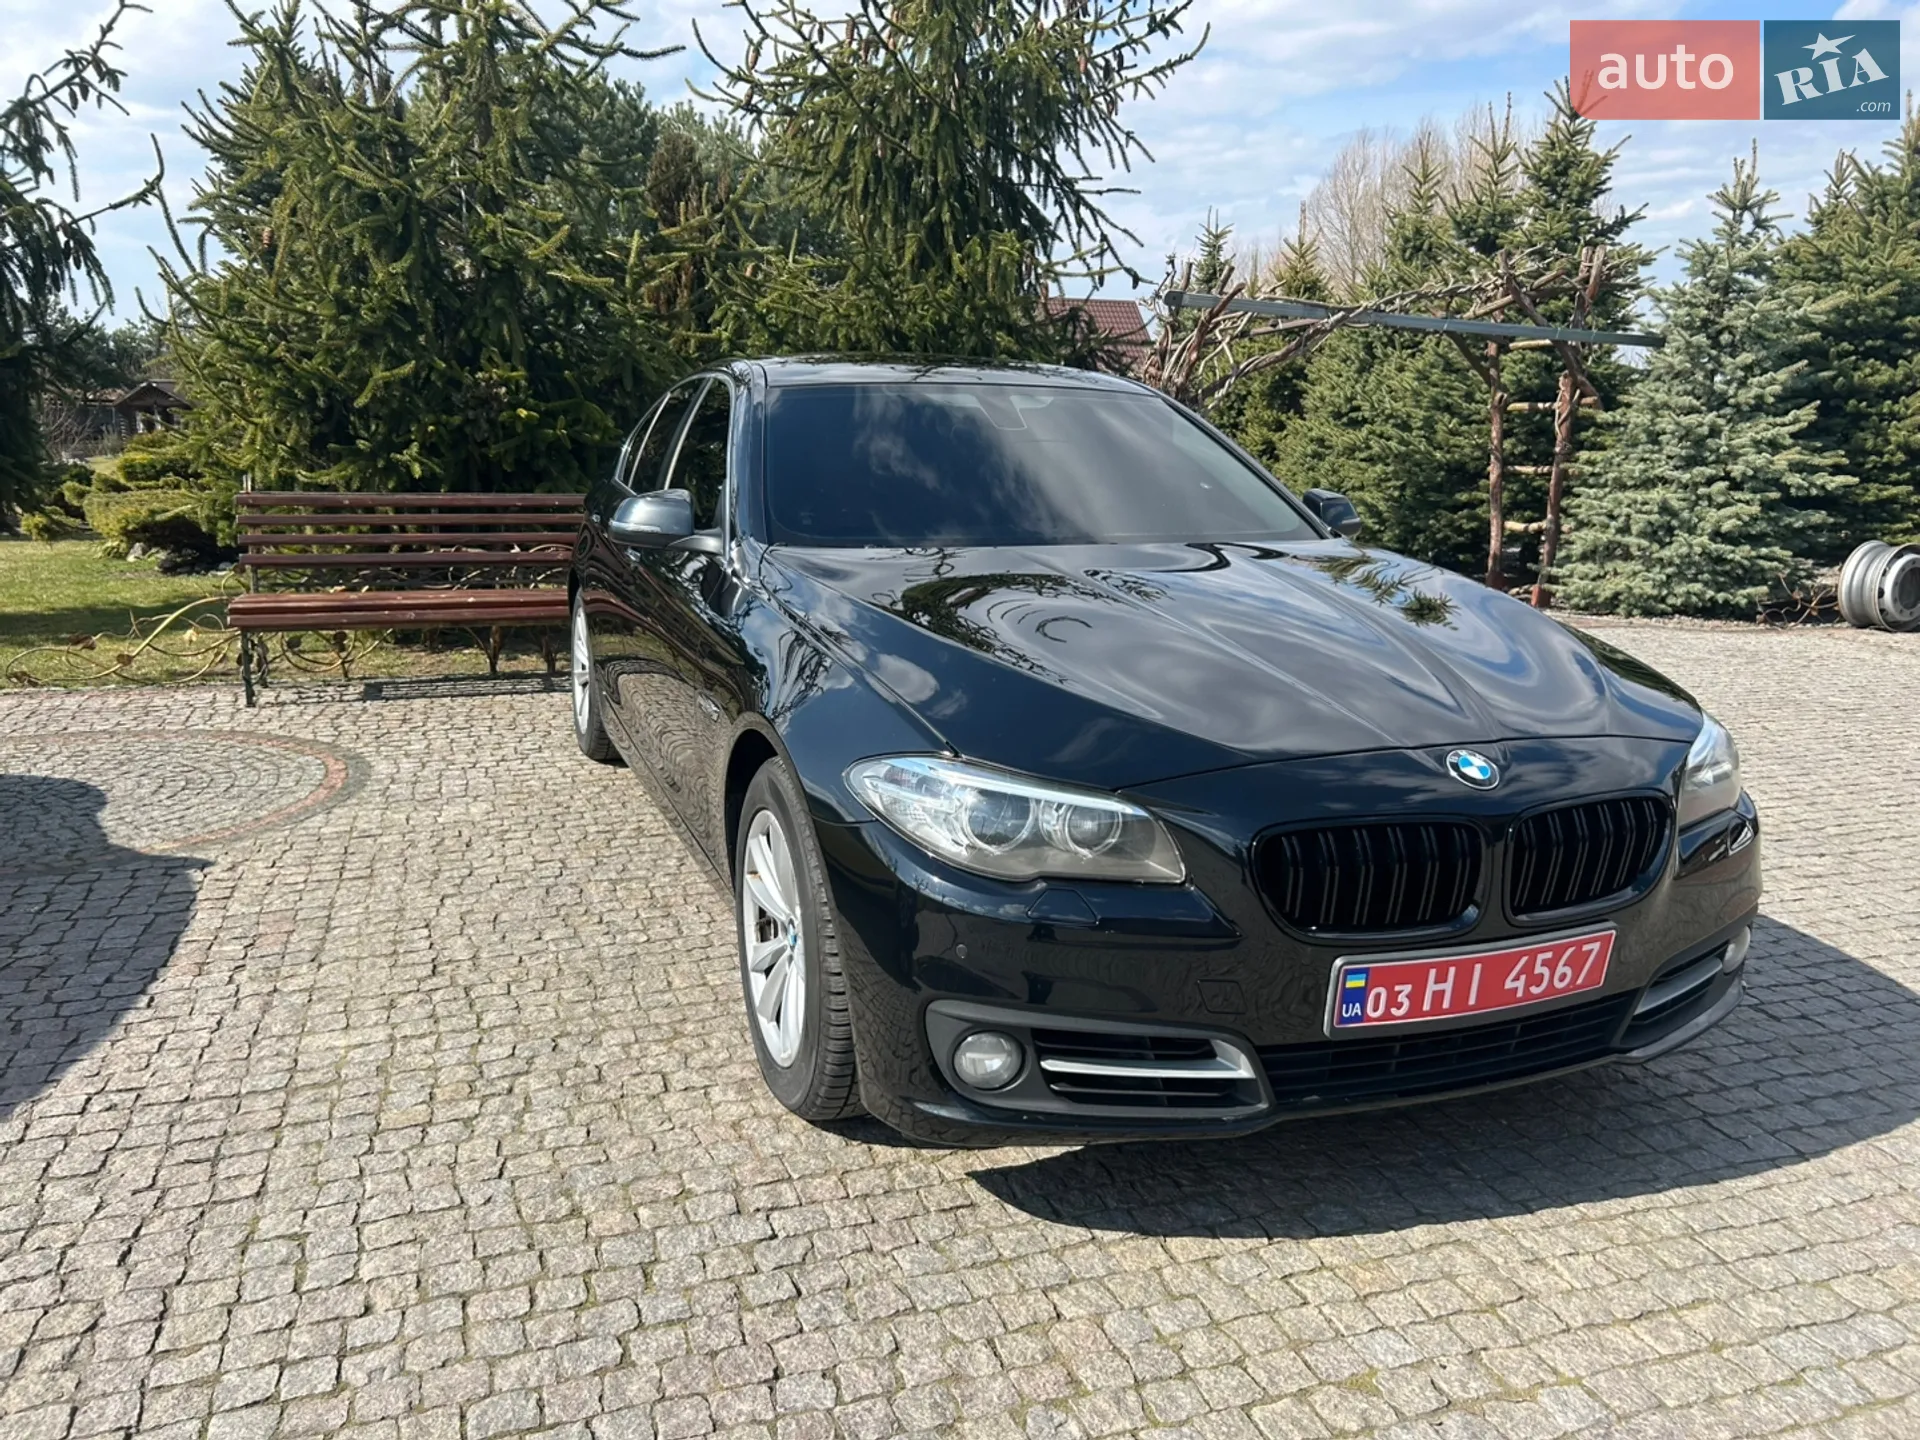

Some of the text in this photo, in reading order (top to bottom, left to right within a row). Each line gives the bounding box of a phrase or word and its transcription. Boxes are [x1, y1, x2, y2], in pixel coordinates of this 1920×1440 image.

[1366, 984, 1412, 1018] 03
[1504, 941, 1601, 998] 4567
[1342, 1003, 1362, 1018] UA
